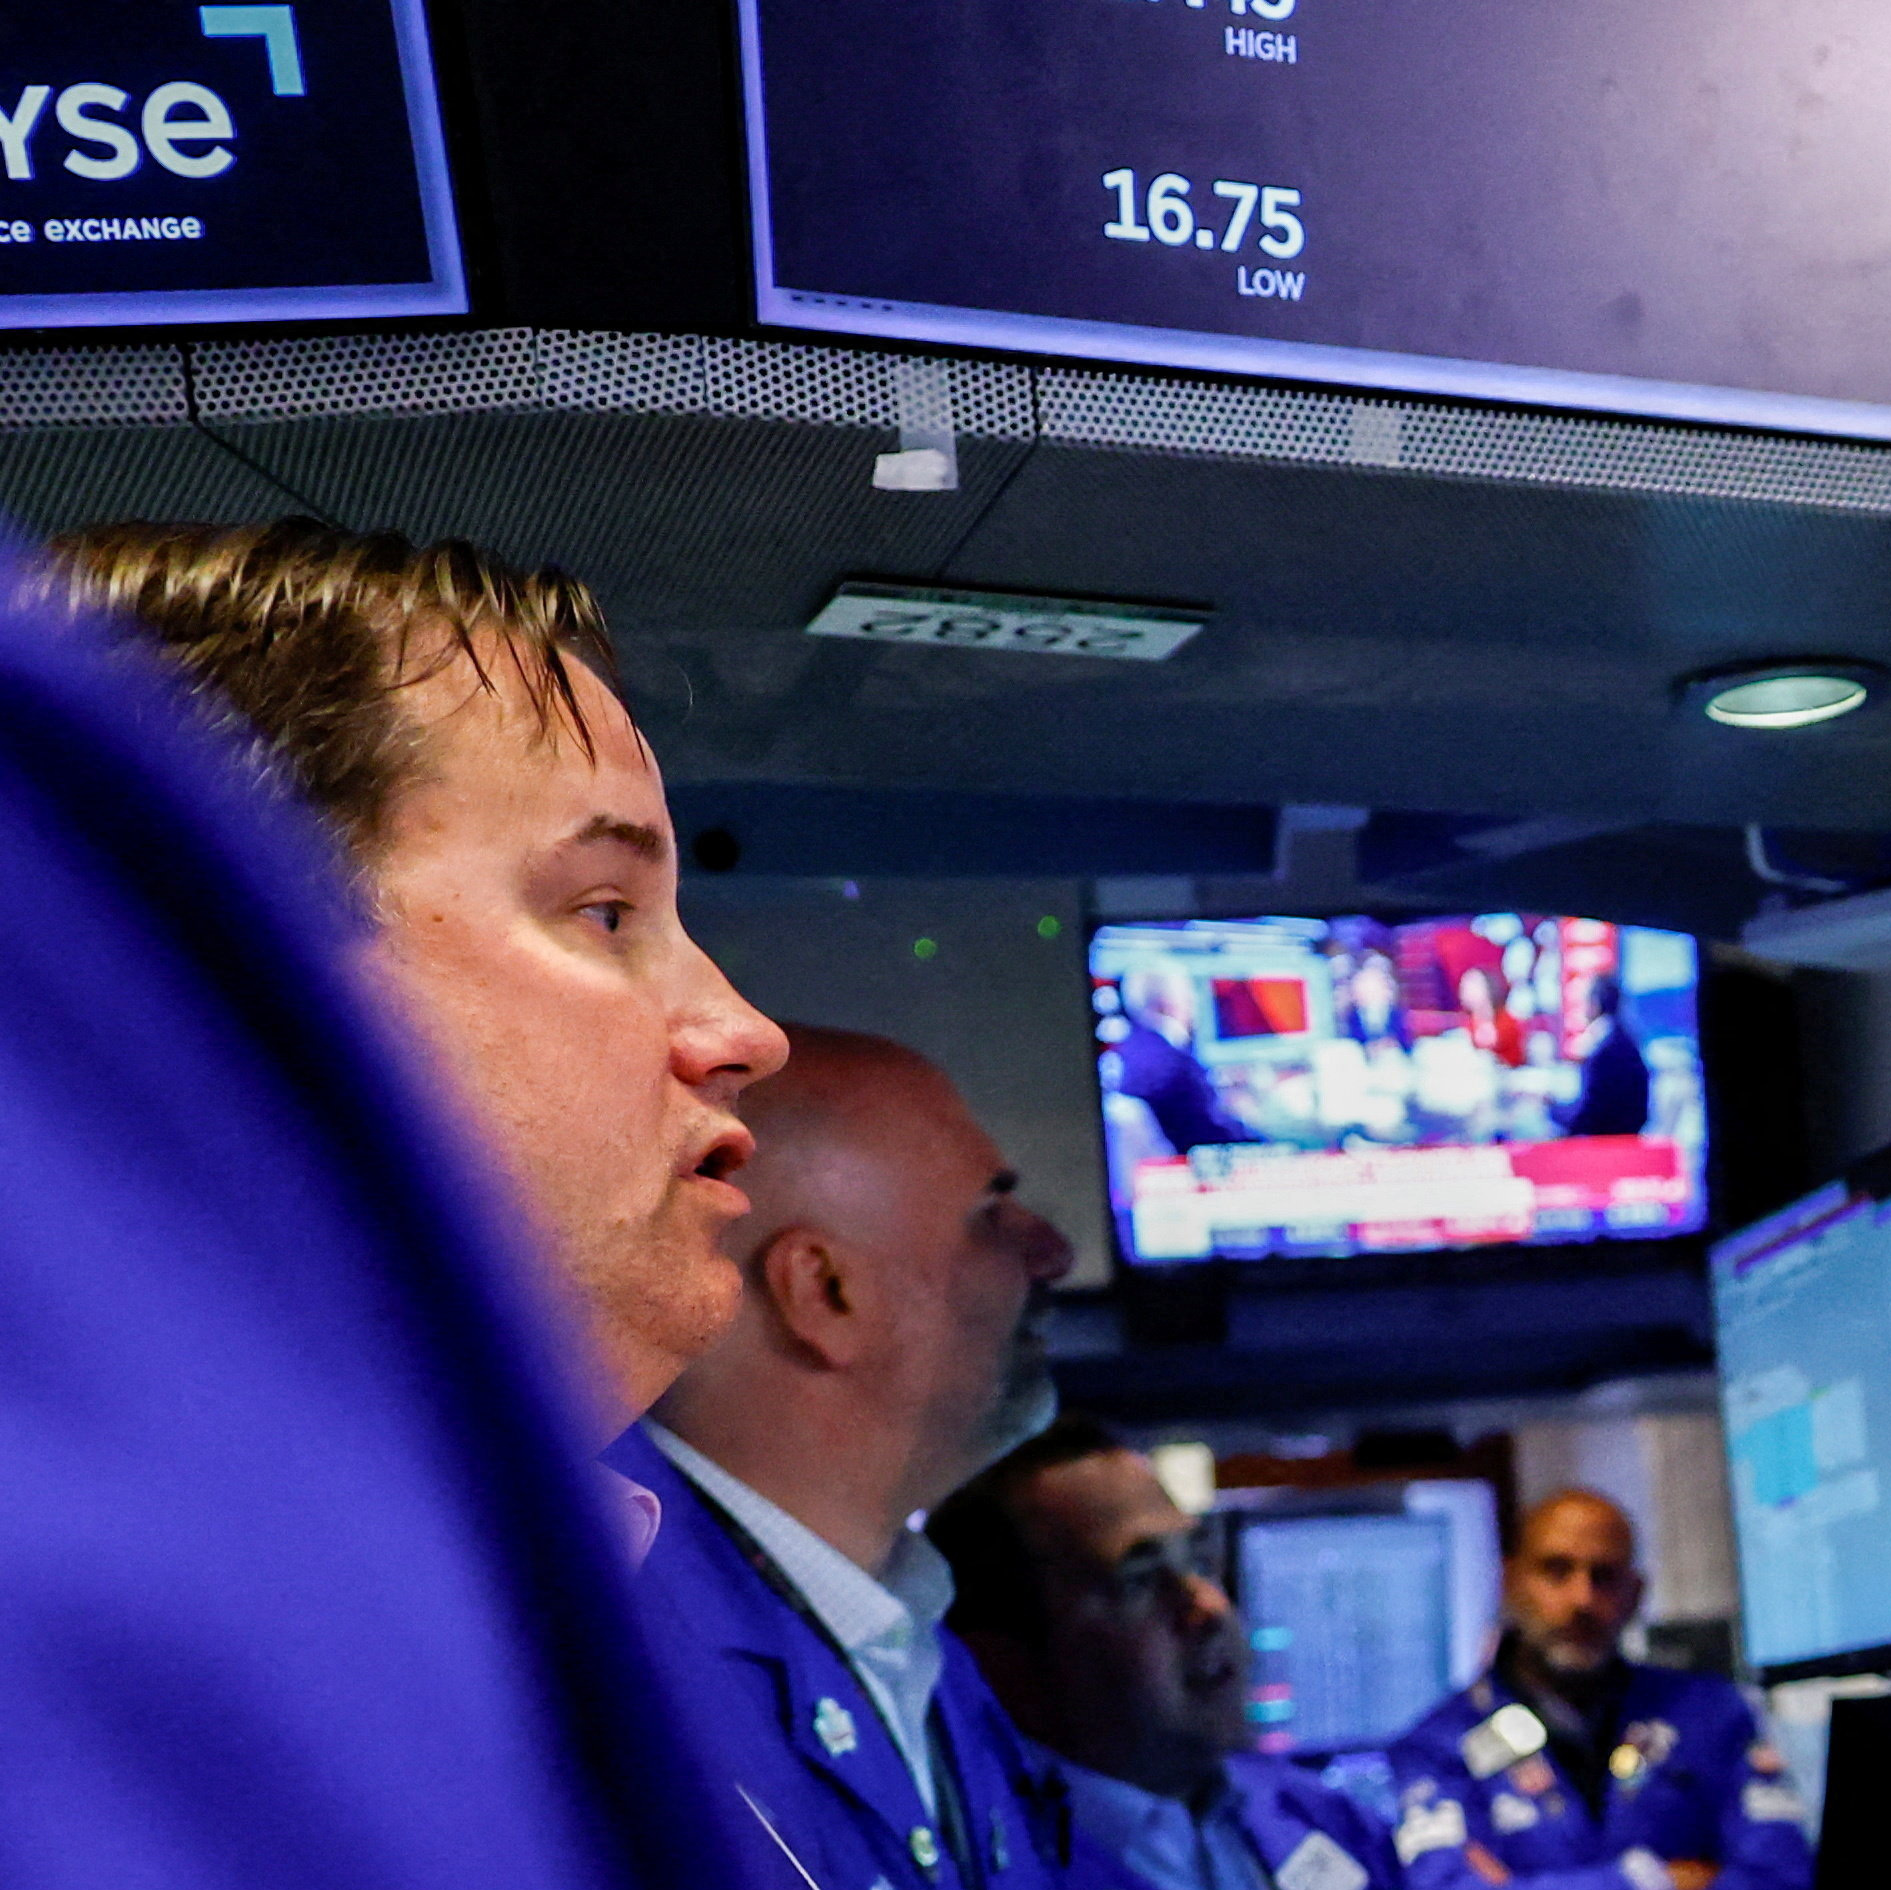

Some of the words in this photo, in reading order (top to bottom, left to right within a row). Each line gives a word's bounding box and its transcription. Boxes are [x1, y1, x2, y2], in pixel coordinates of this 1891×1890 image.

[1225, 26, 1297, 64] HIGH
[1102, 168, 1305, 259] 16.75
[1238, 266, 1305, 299] LOW
